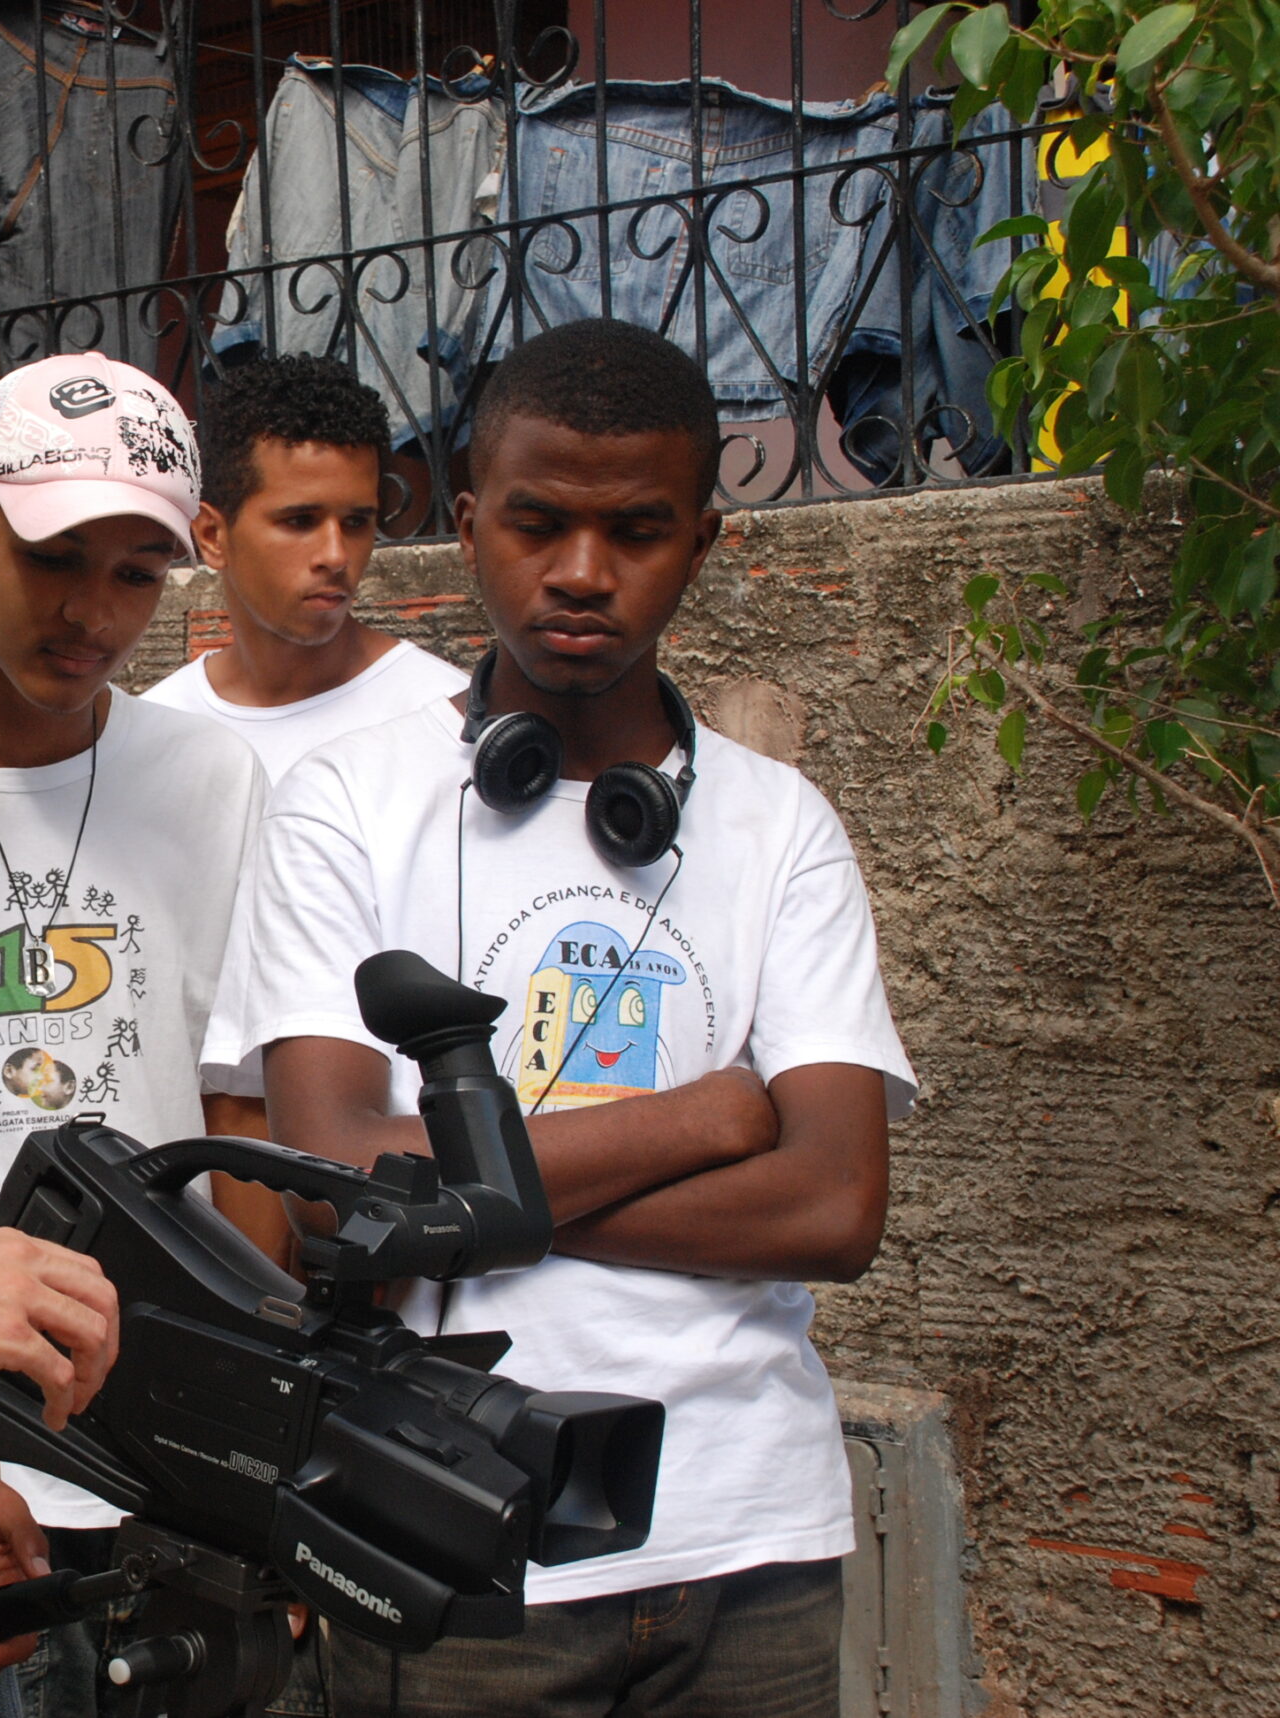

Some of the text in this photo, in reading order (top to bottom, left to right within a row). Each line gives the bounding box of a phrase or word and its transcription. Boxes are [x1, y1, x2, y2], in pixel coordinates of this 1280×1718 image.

[28, 947, 49, 985] B
[474, 885, 716, 1055] ATUTO DA CRIANÇA E DO ADOLESCENTE
[558, 940, 623, 969] ECA
[647, 962, 678, 976] ANOS
[525, 991, 556, 1071] ECA
[423, 1223, 462, 1235] Panasonic
[295, 1541, 403, 1624] Panasonic
